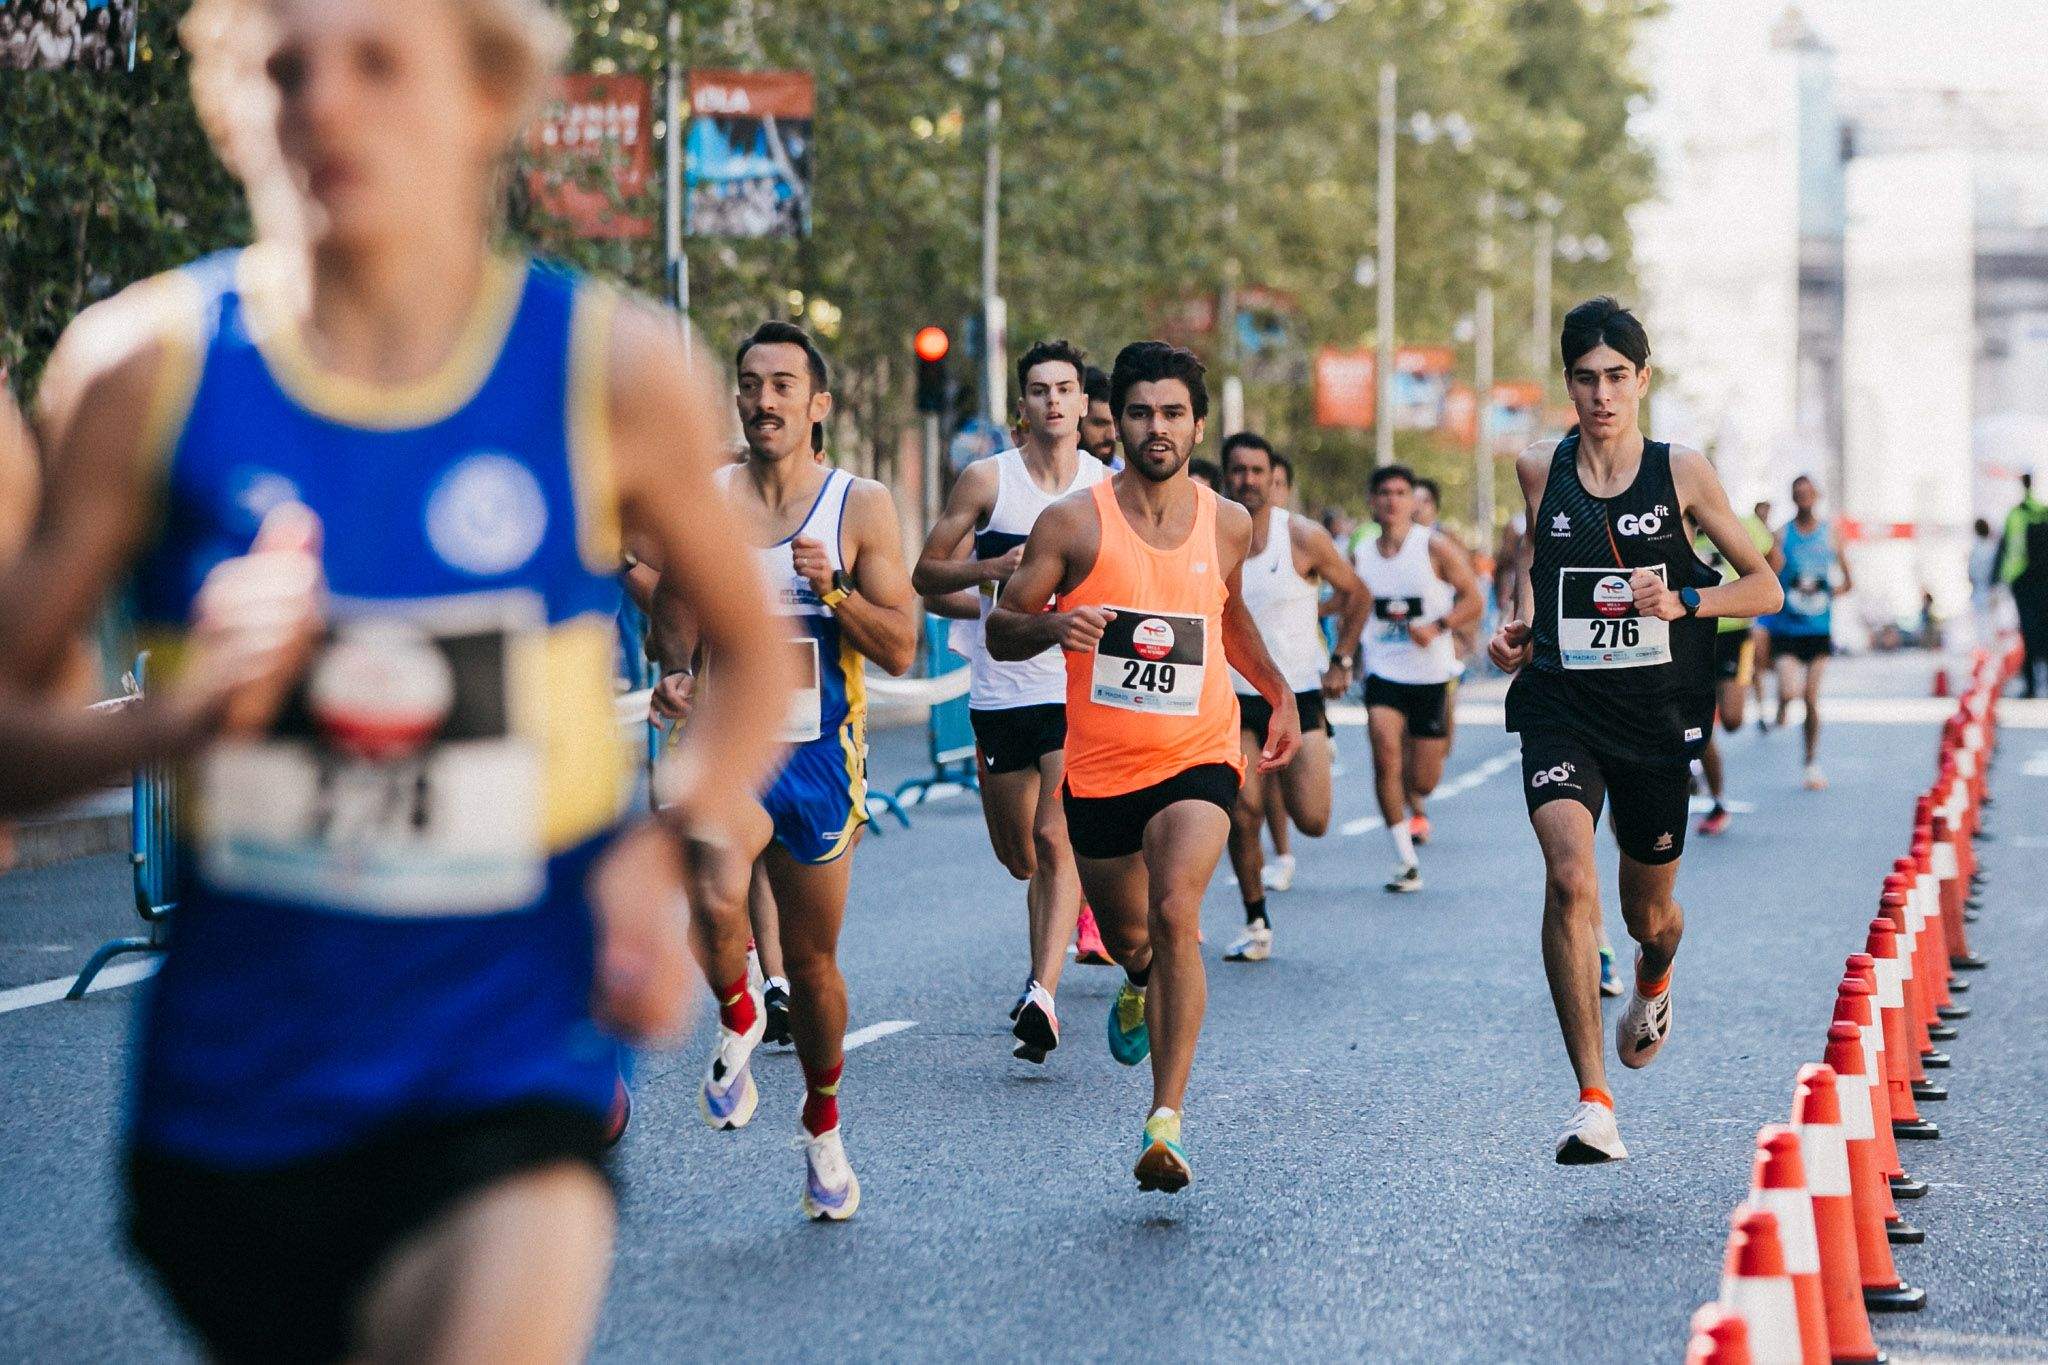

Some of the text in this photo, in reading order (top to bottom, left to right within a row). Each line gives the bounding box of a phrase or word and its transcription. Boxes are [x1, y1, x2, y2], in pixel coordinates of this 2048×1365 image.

[1617, 504, 1669, 536] GO fit
[1589, 619, 1640, 648] 276
[1122, 661, 1175, 693] 249
[1532, 762, 1575, 787] GO fit
